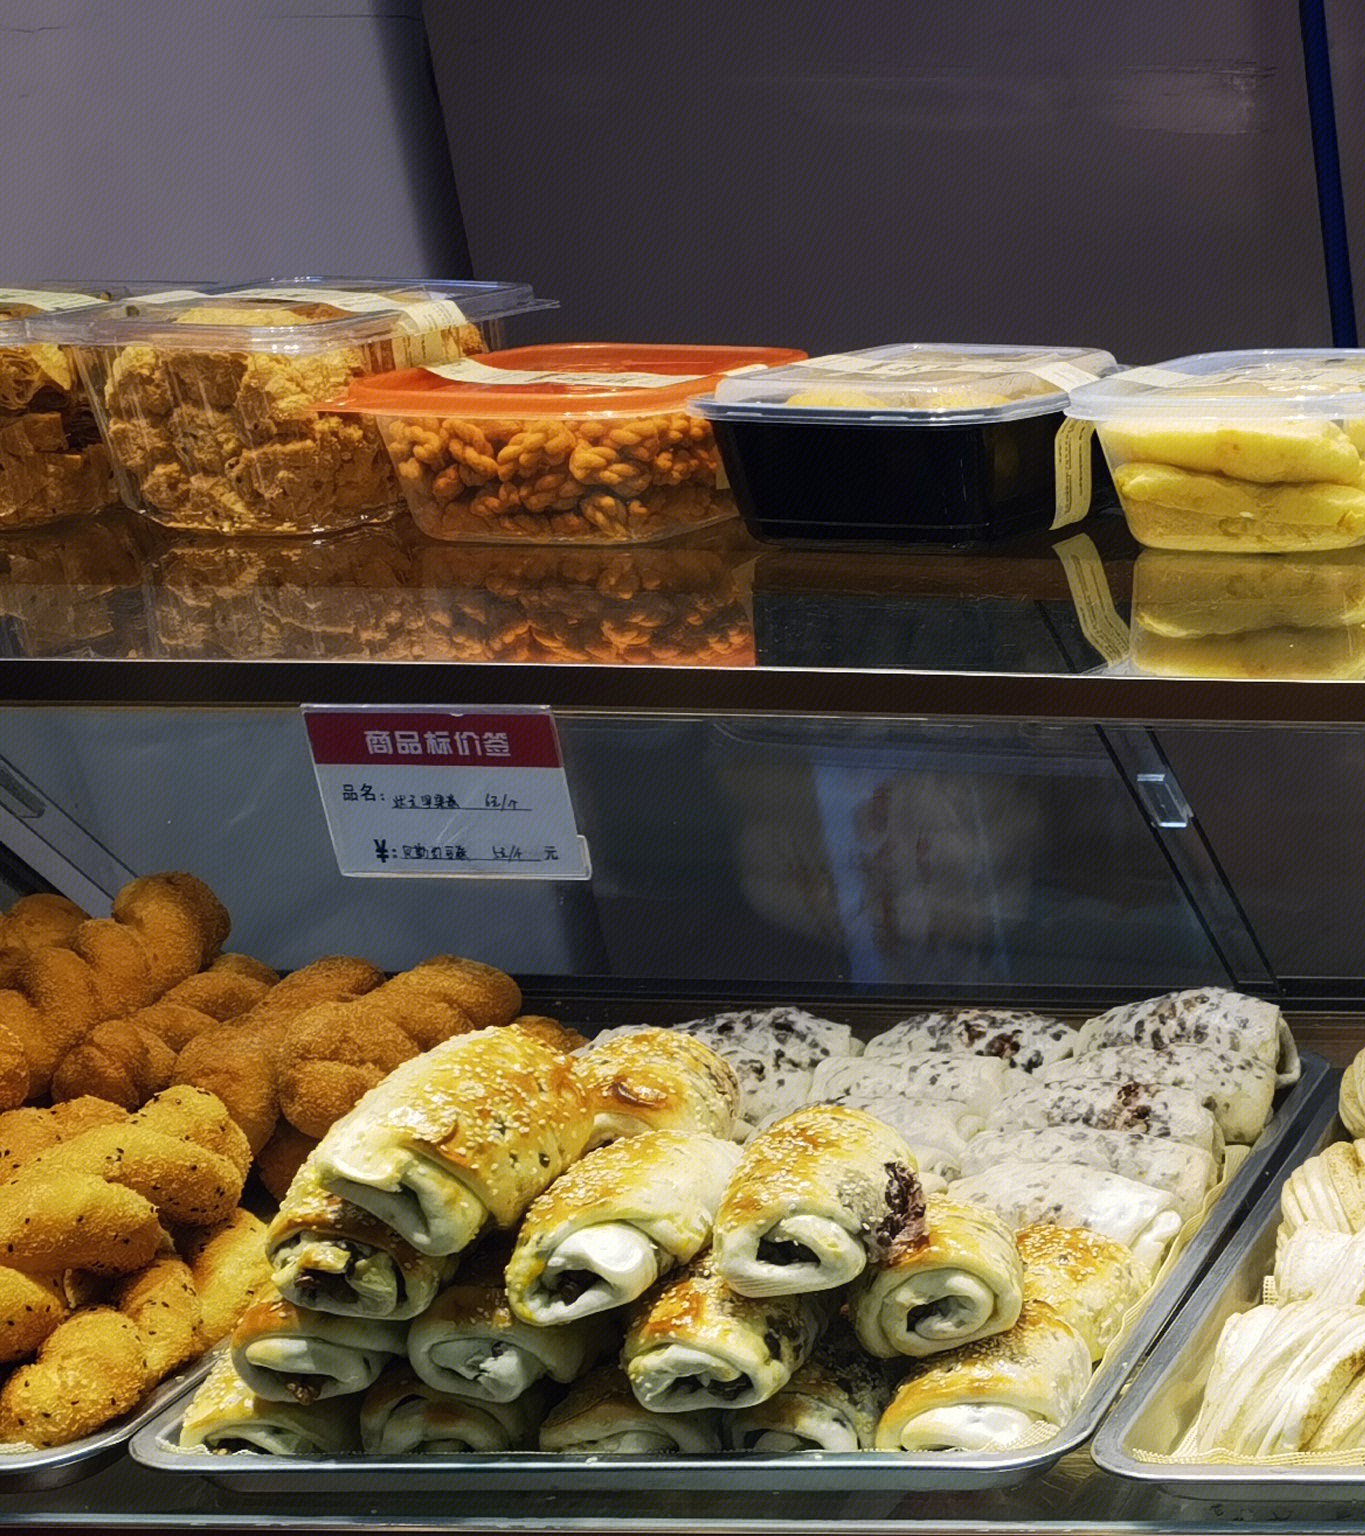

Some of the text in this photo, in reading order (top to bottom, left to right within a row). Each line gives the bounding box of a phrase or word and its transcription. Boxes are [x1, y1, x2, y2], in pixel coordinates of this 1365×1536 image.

[364, 730, 511, 757] 商品标价签
[543, 845, 559, 861] 元
